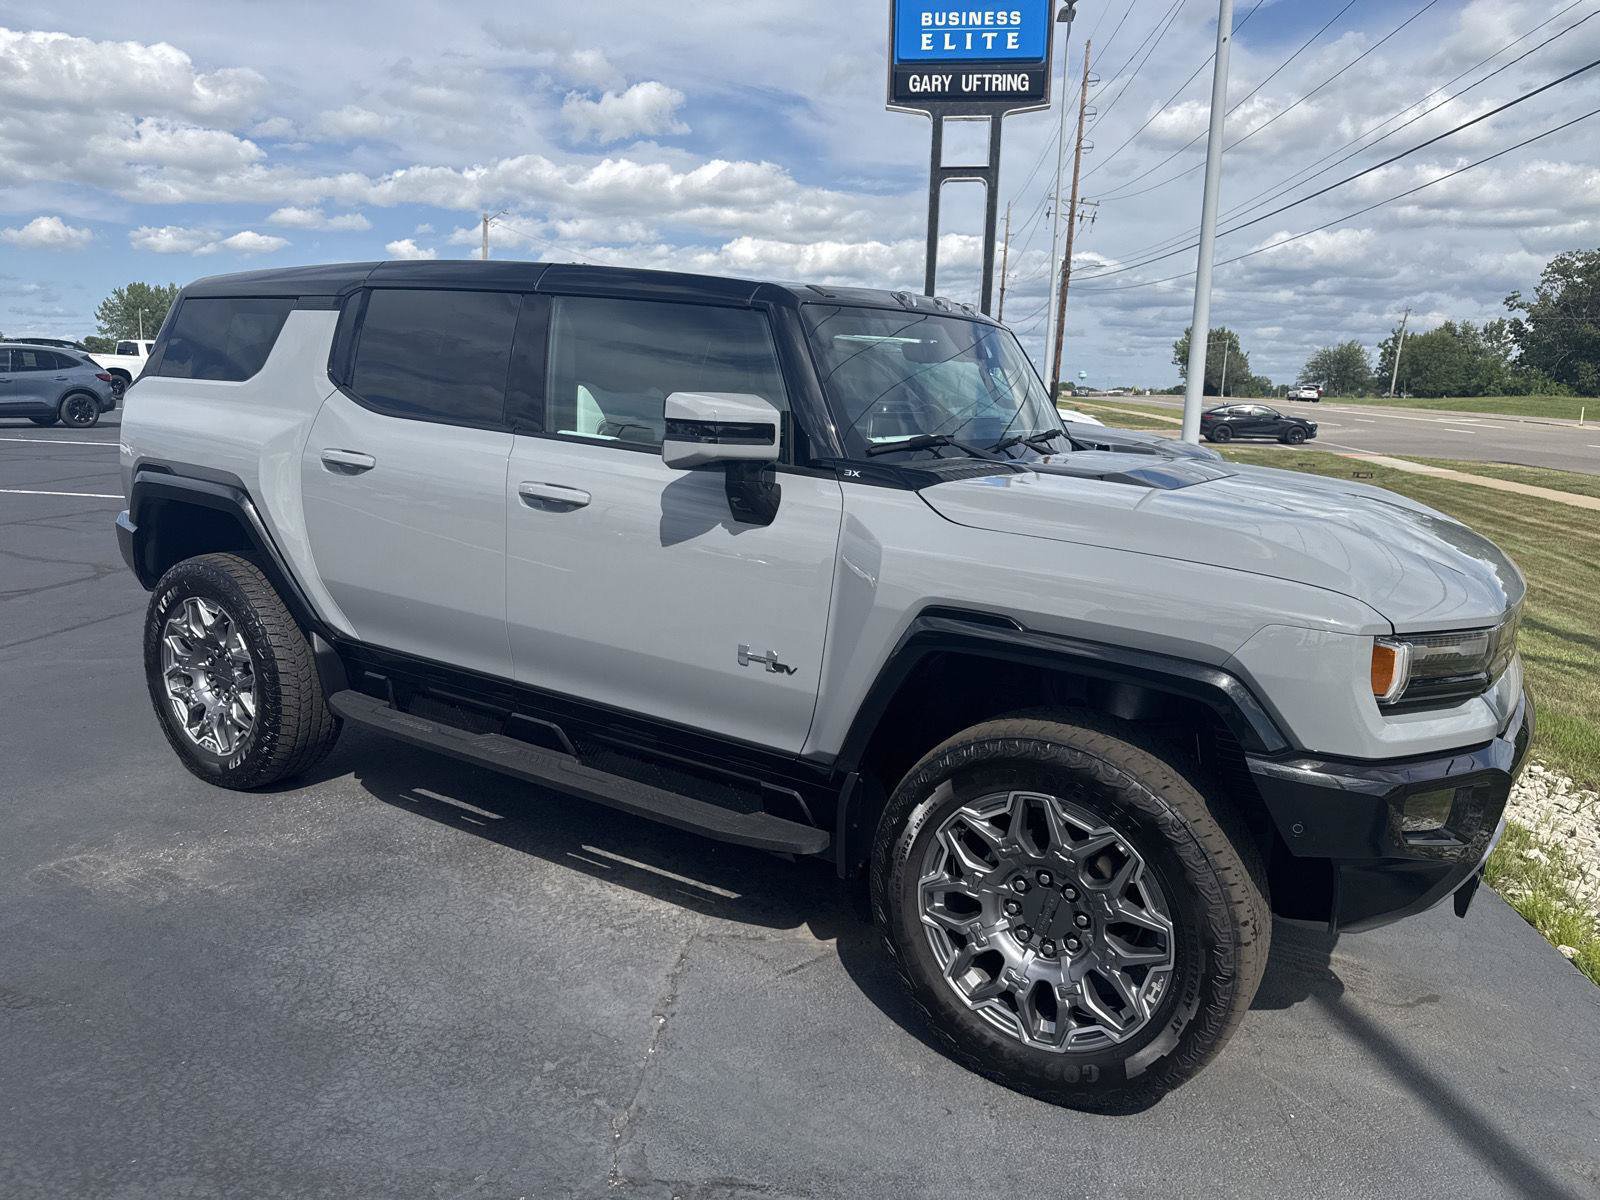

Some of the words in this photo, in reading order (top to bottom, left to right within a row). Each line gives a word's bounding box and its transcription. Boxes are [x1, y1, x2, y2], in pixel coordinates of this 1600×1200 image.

[921, 11, 1021, 26] BUSINESS
[921, 32, 1020, 50] ELITE
[909, 74, 953, 93] GARY
[961, 73, 1030, 92] UFTRING
[843, 469, 861, 478] 3X
